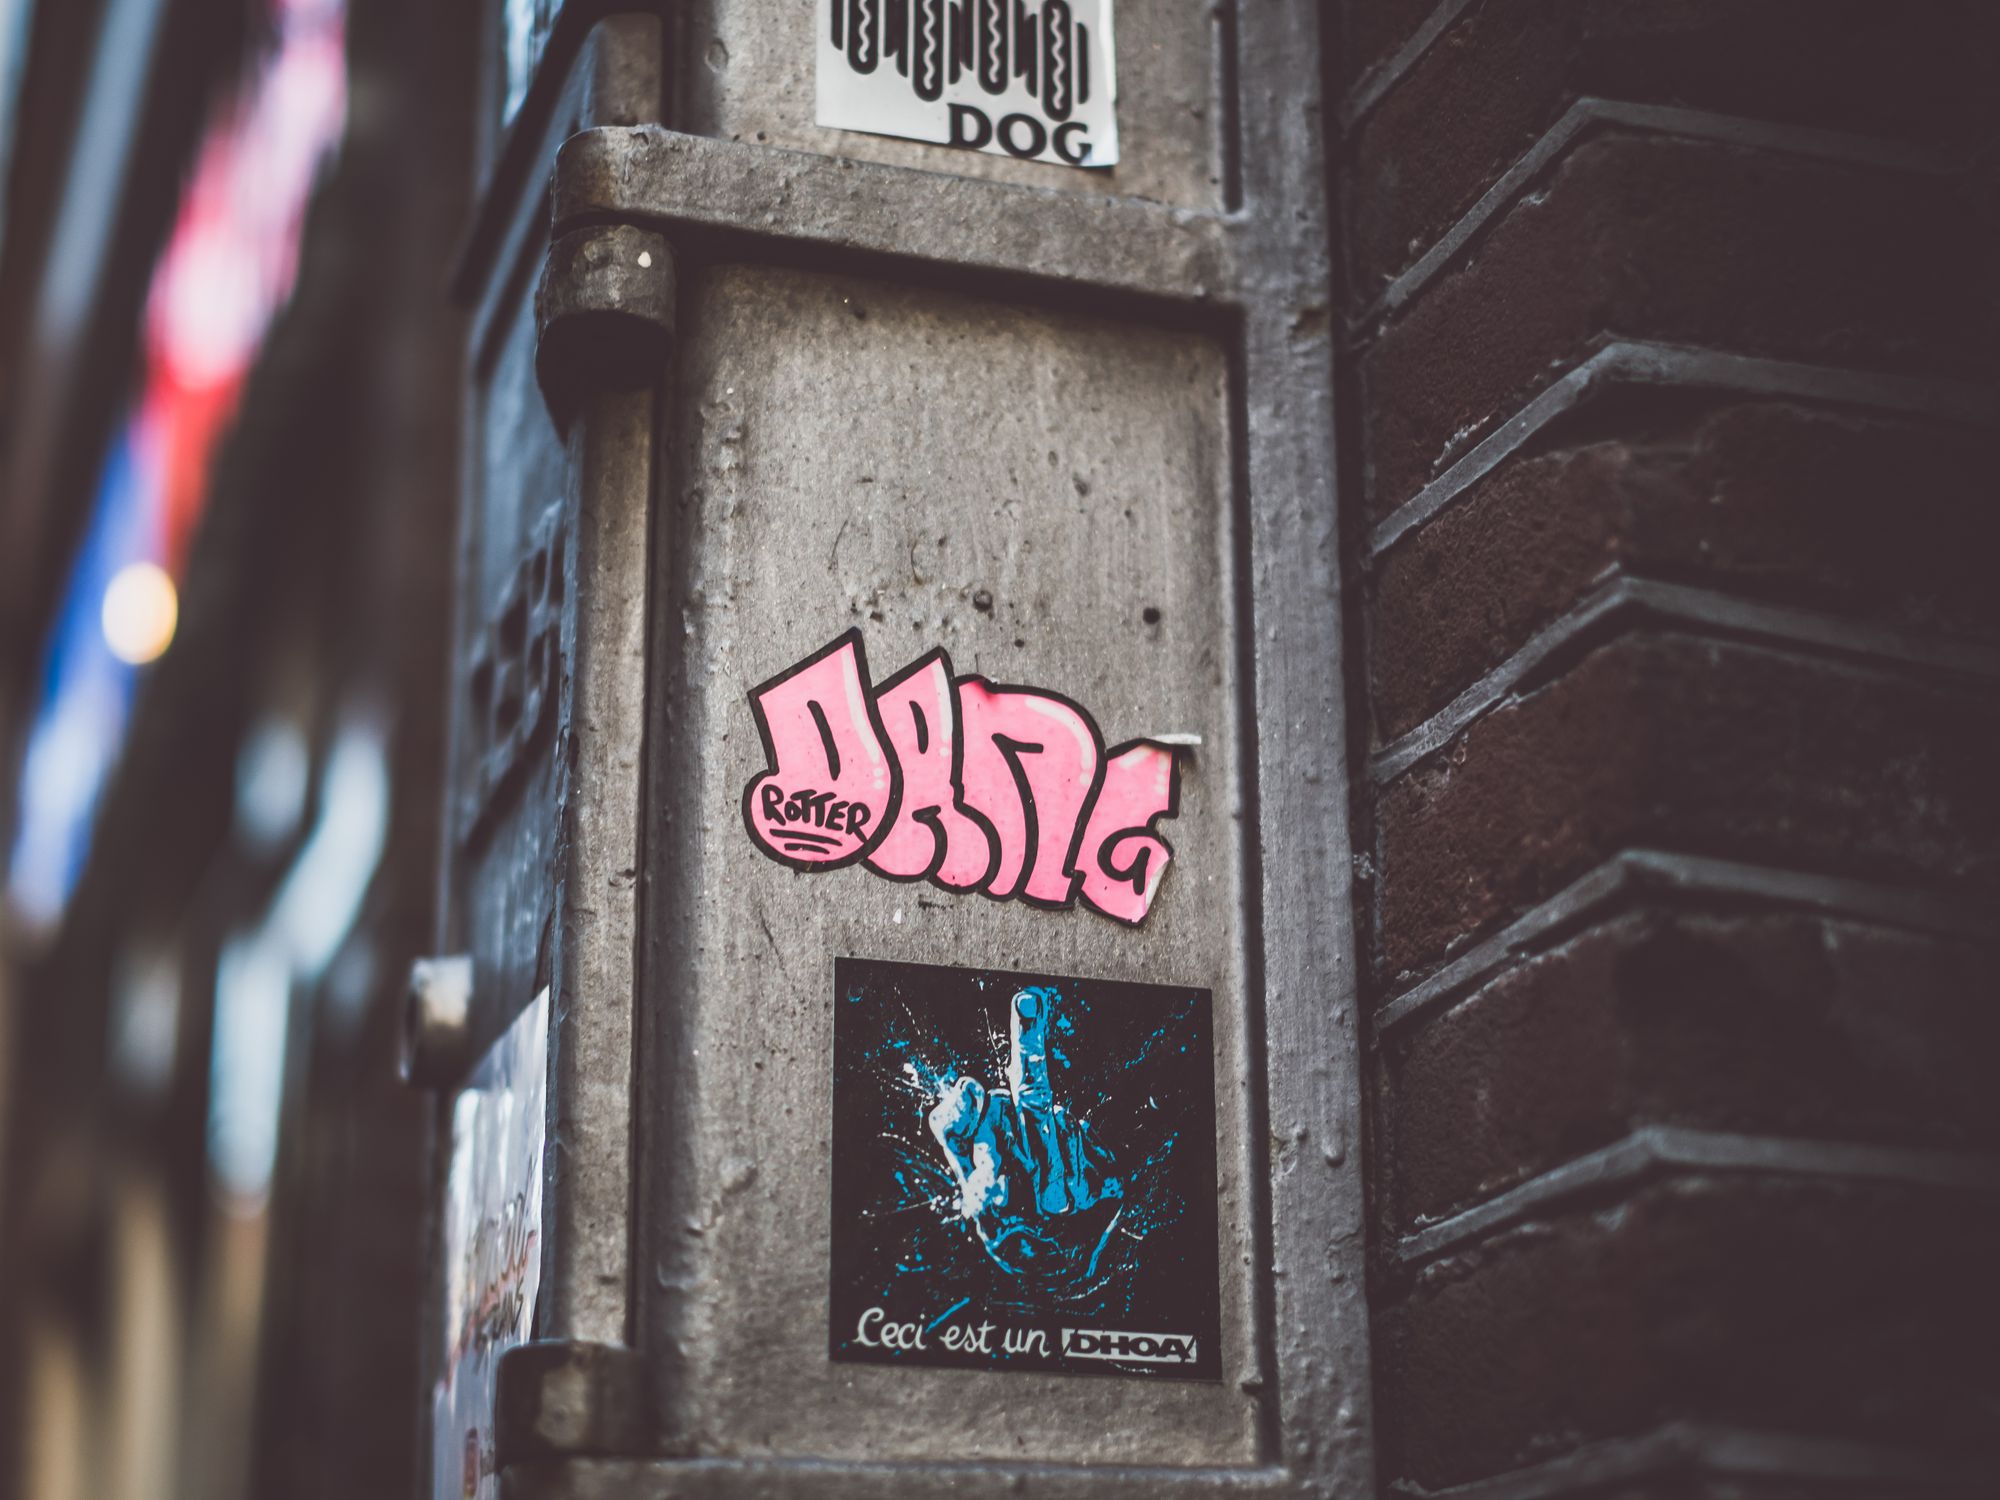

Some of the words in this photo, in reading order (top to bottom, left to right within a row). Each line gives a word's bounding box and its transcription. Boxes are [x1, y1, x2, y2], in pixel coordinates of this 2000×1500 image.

[947, 102, 1093, 165] DOG
[761, 784, 871, 843] ROTTER
[852, 1306, 927, 1350] Ceci
[938, 1320, 997, 1354] est
[1001, 1327, 1051, 1358] un
[1066, 1330, 1193, 1363] DHOA
